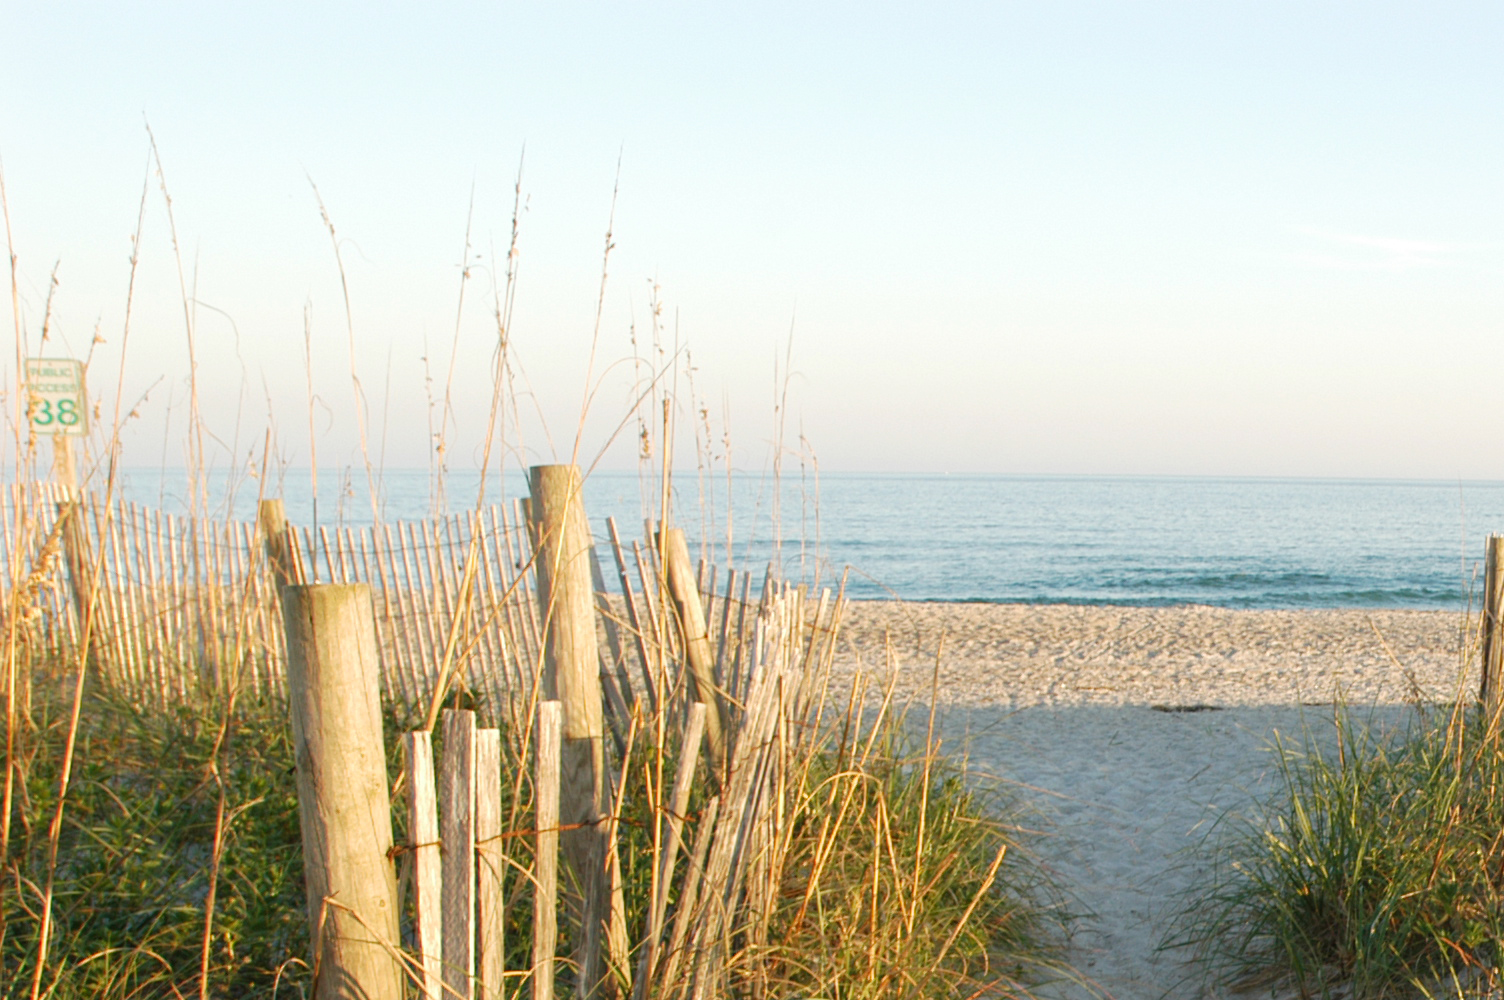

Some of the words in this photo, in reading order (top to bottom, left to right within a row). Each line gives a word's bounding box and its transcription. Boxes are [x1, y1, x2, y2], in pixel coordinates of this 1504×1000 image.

[29, 368, 72, 377] PUBLIC
[29, 383, 77, 393] ACCESS
[33, 398, 79, 426] 38
